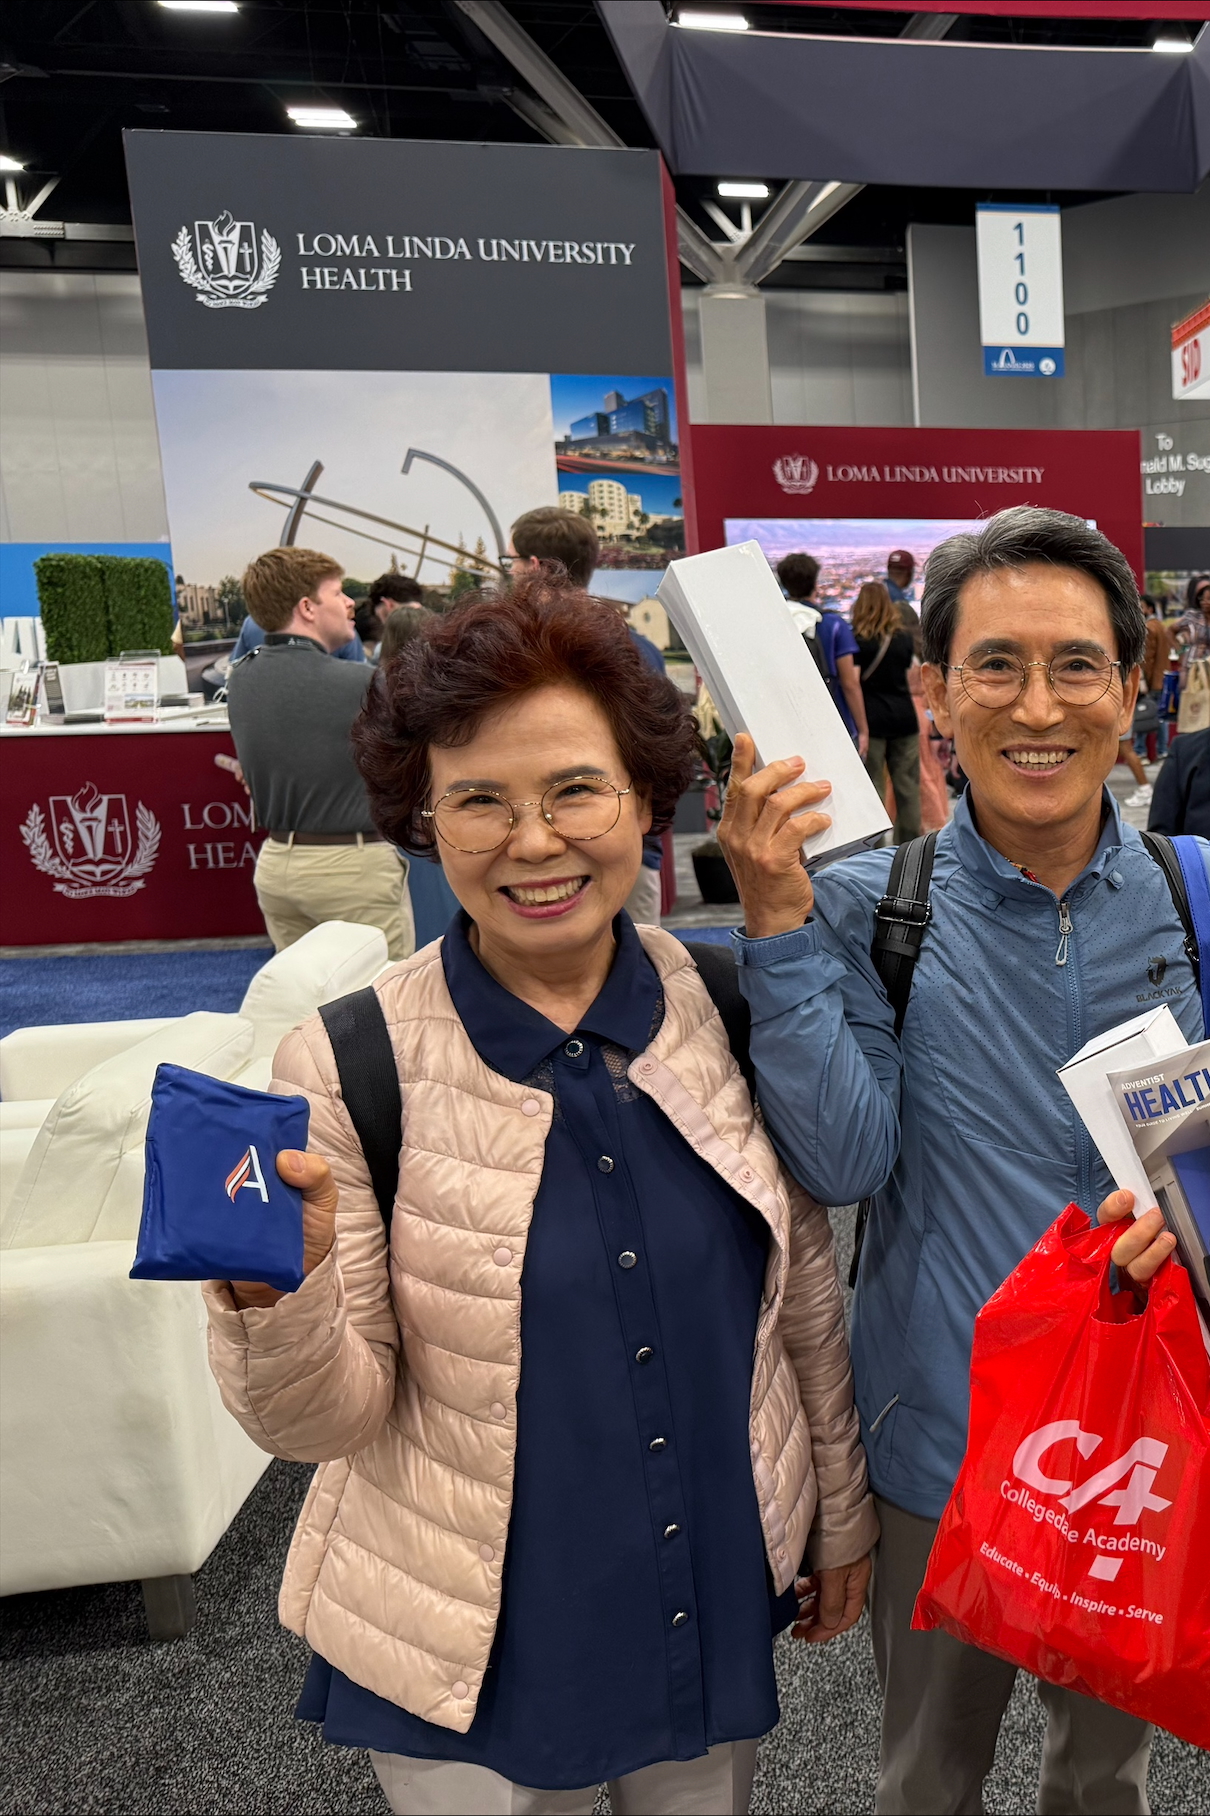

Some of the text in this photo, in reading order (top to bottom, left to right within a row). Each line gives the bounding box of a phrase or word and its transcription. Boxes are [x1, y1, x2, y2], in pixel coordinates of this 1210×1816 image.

[297, 233, 636, 266] LOMA LINDA UNIVERSITY
[300, 265, 412, 292] HEALTH
[1013, 222, 1029, 336] 1100
[1155, 433, 1173, 451] To
[826, 464, 1045, 486] LOMA LINDA UNIVERSITY
[1146, 477, 1186, 497] Lobby
[180, 801, 251, 829] LOM
[186, 840, 257, 869] HEA
[1121, 1073, 1165, 1091] ADVENTIST
[1000, 1480, 1167, 1561] Collegedae Academy
[979, 1541, 1164, 1624] Educate Equip Inspire Serve
